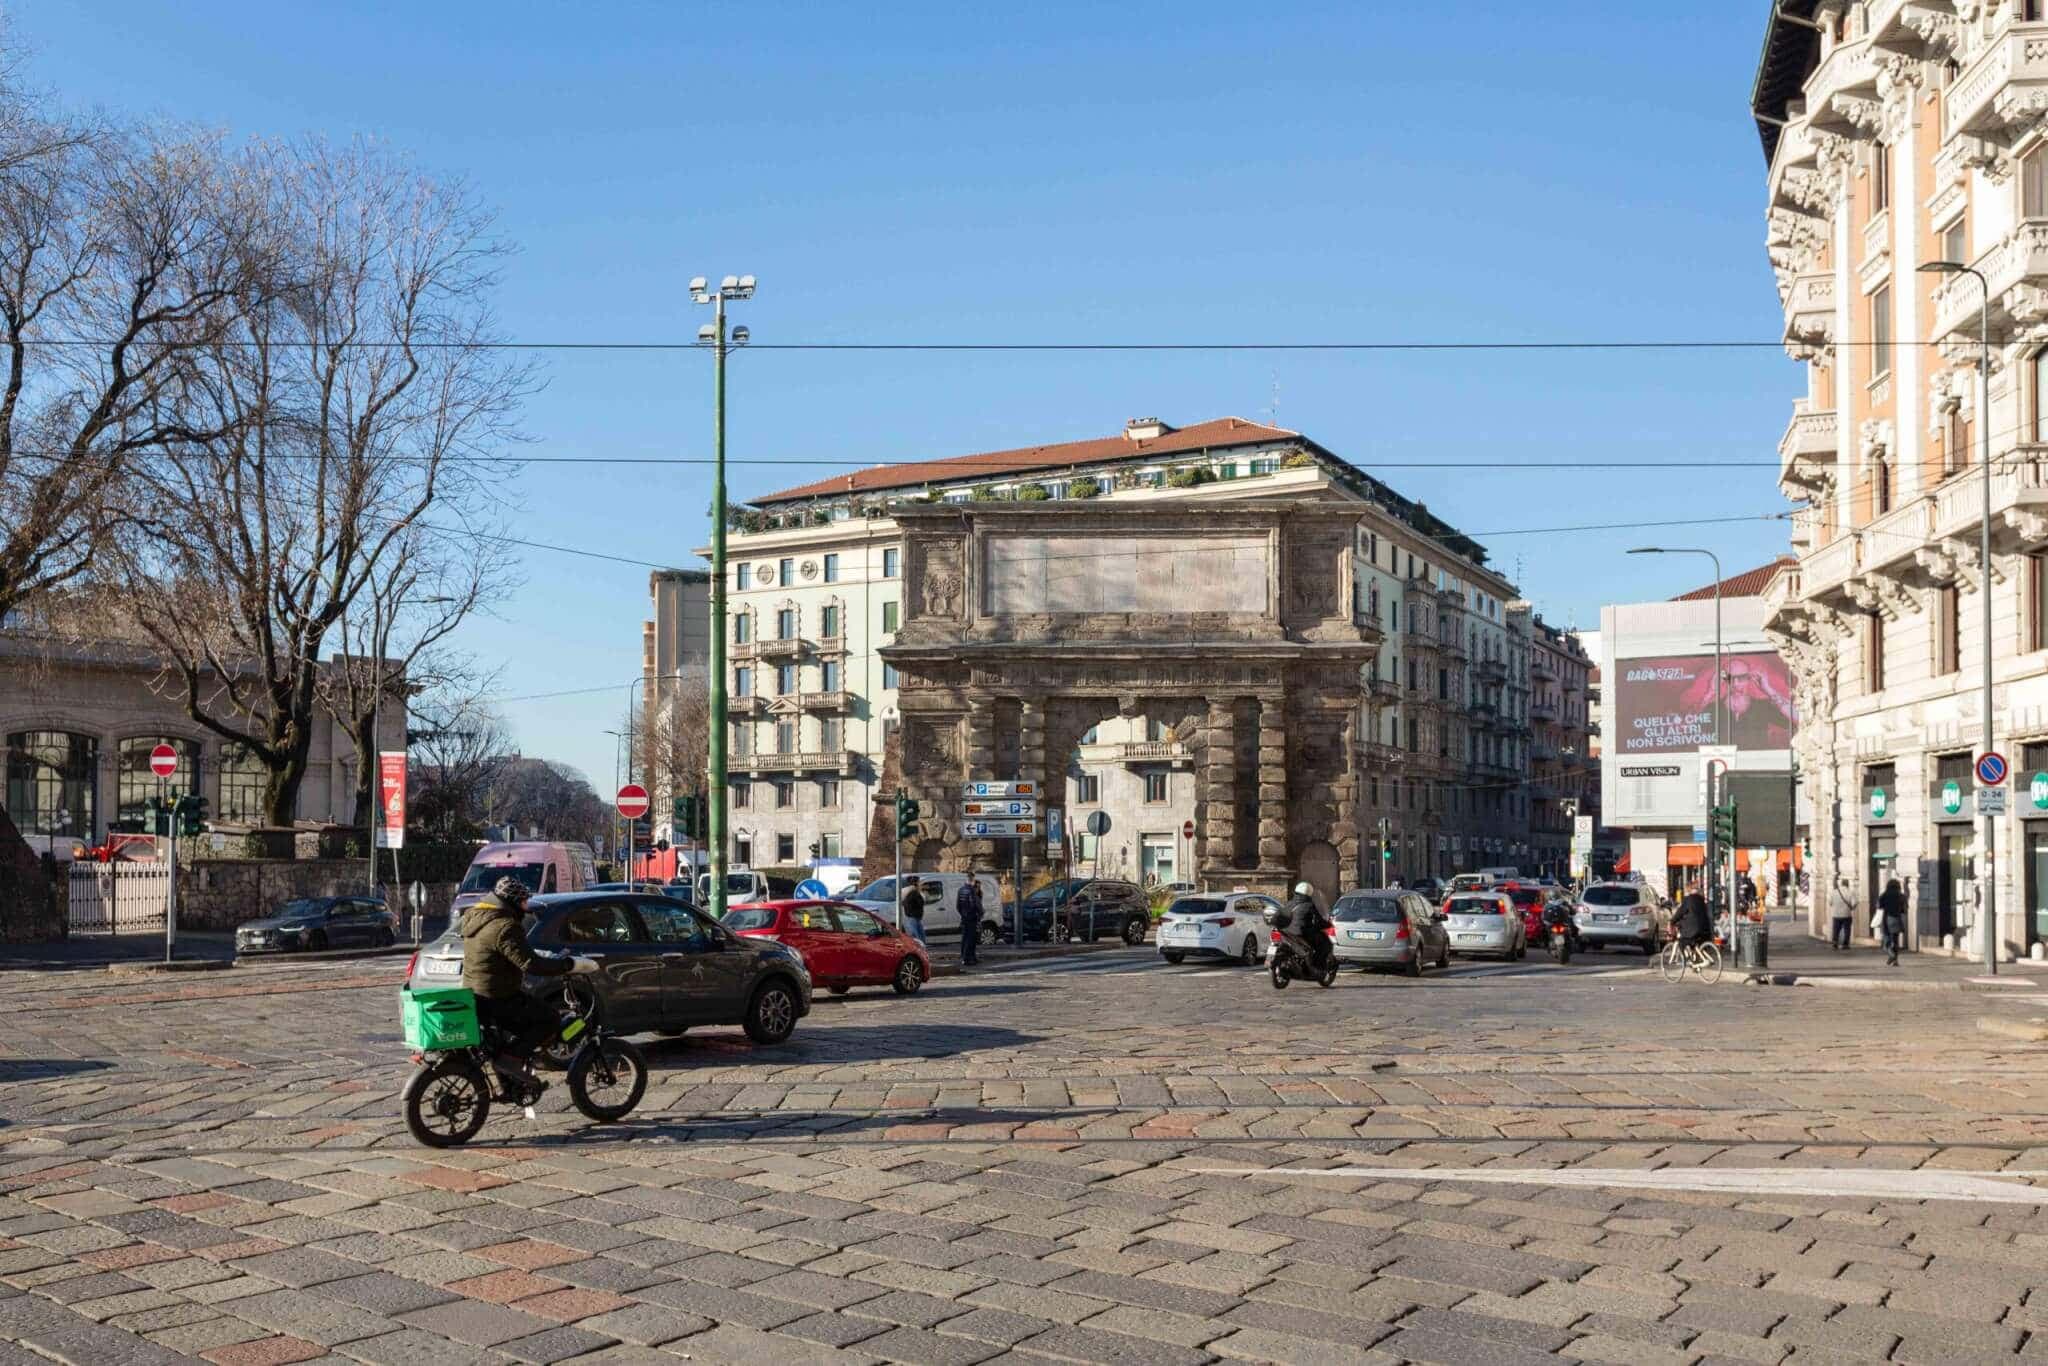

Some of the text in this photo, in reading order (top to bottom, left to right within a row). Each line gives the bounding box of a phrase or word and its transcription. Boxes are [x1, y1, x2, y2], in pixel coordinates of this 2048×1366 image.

[1633, 712, 1712, 729] QUELLO CHE
[1644, 724, 1701, 738] GLI ALTRI
[1626, 737, 1653, 749] NON
[1621, 766, 1679, 777] URBAN VISION
